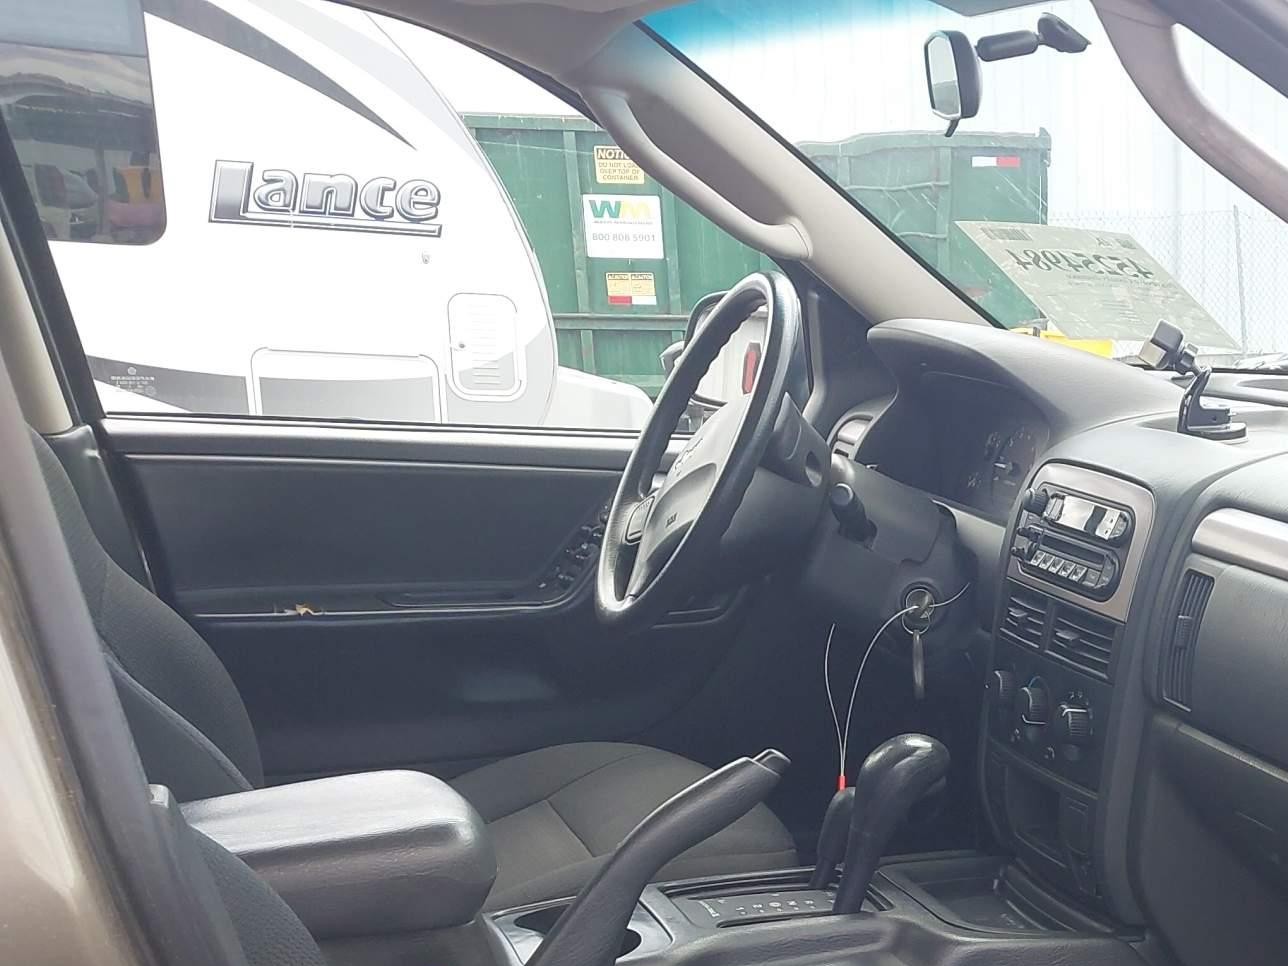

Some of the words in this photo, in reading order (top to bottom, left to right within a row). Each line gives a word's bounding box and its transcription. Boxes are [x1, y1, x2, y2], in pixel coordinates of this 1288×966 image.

[597, 149, 630, 159] NOTI
[208, 160, 442, 237] Lance
[592, 233, 610, 241] 800
